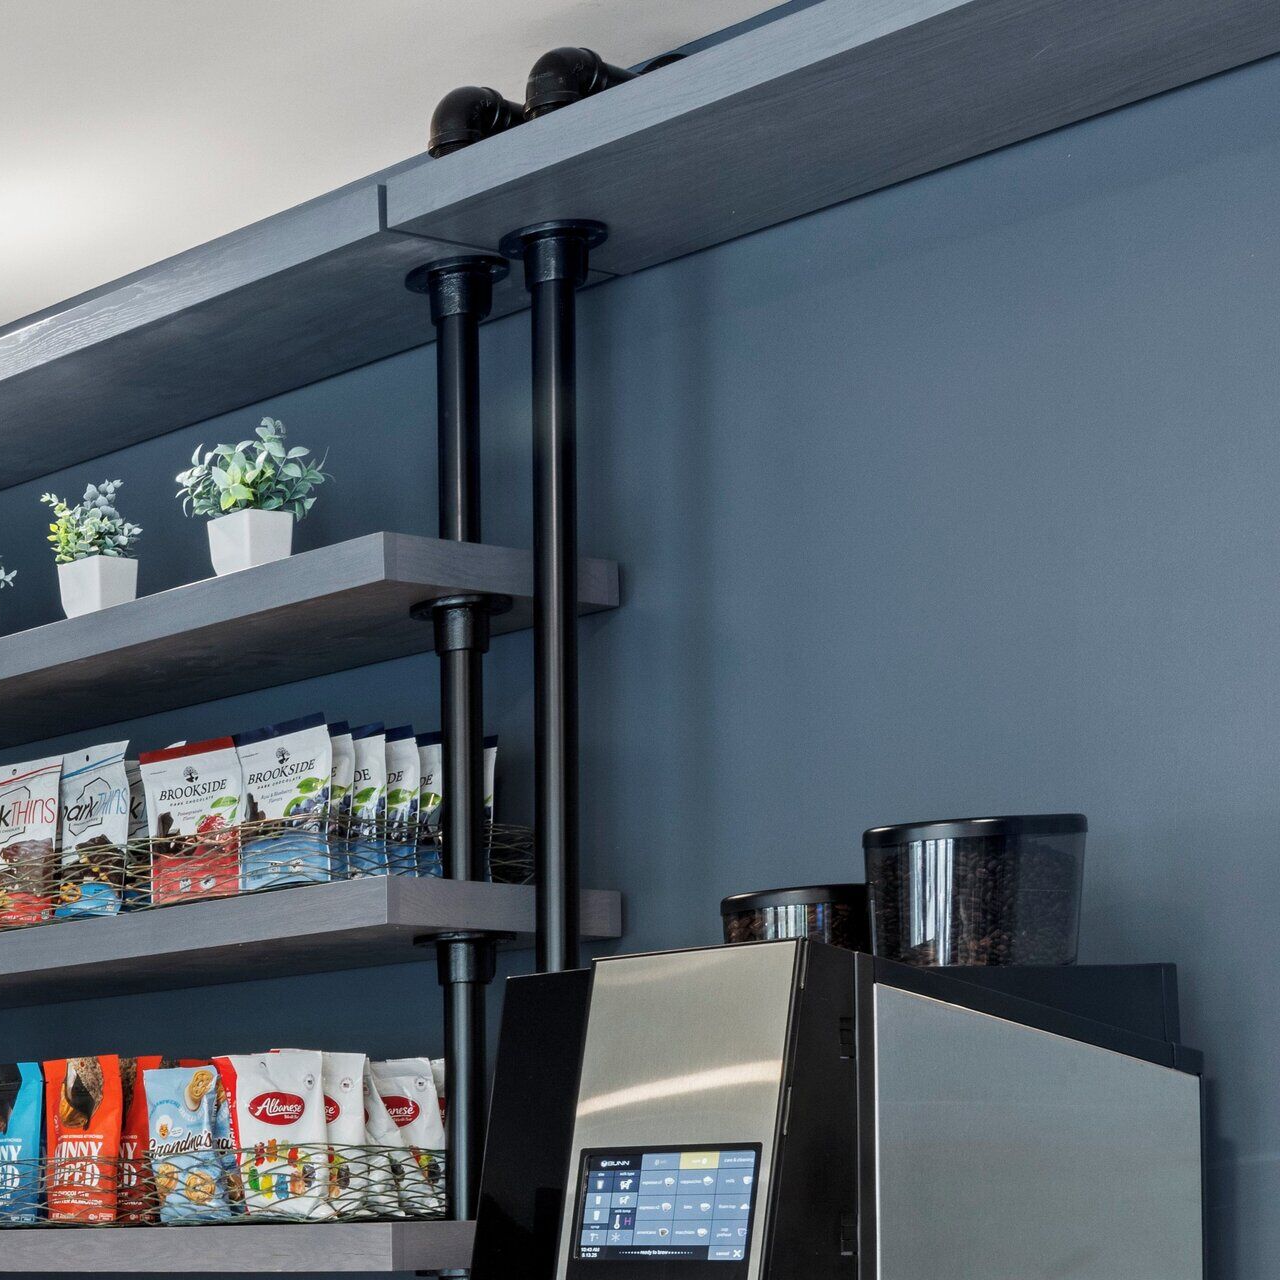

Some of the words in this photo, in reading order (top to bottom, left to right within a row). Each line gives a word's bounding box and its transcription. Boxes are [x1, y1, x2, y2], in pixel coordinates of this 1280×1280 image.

[247, 758, 317, 785] BROOKSIDE
[159, 778, 228, 801] BROOKSIDE
[255, 1097, 302, 1117] Albanese
[388, 1104, 416, 1116] anese
[149, 1131, 212, 1158] Grandma's
